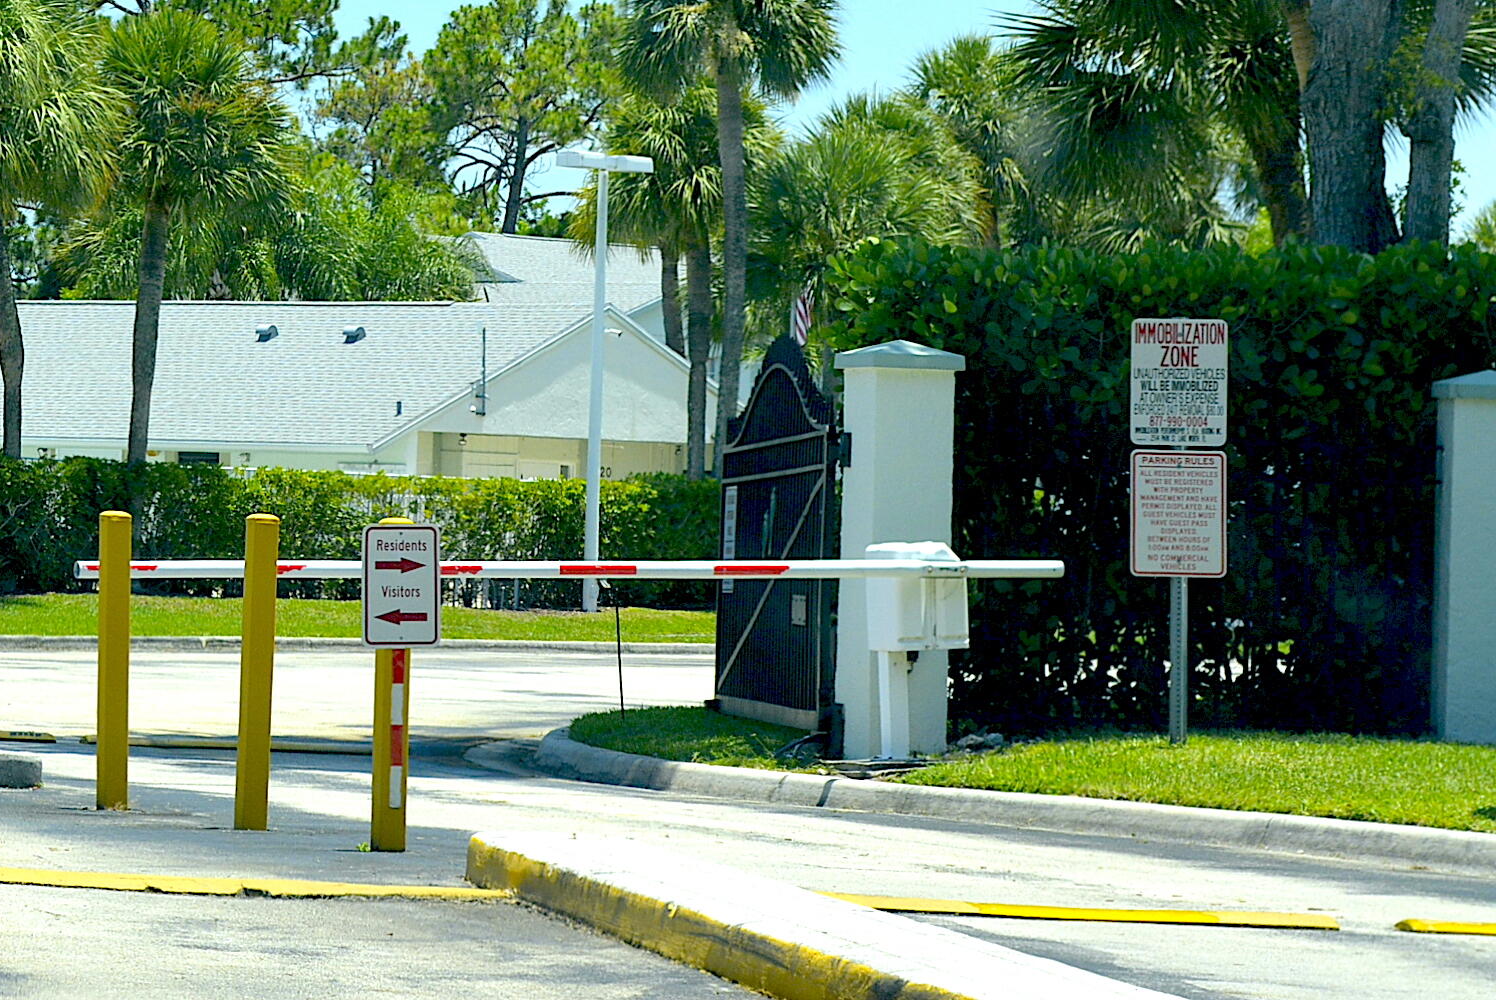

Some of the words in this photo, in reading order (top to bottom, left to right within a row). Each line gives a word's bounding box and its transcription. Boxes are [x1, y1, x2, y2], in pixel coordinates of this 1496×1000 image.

[1135, 323, 1225, 344] IMMOBILIZATION
[1160, 346, 1199, 367] ZONE
[1134, 368, 1190, 379] UNAUTHORIZED
[1190, 368, 1225, 380] VEHICLES
[1141, 380, 1158, 391] WILL
[1160, 381, 1170, 391] BE
[1172, 381, 1219, 392] IMMOBILIZED
[1140, 392, 1148, 403] AT
[1186, 393, 1219, 404] EXPENSE
[1142, 456, 1183, 465] PARKING
[376, 540, 428, 552] Residents
[1160, 554, 1209, 562] COMMERCIAL
[382, 586, 421, 598] Visitors
